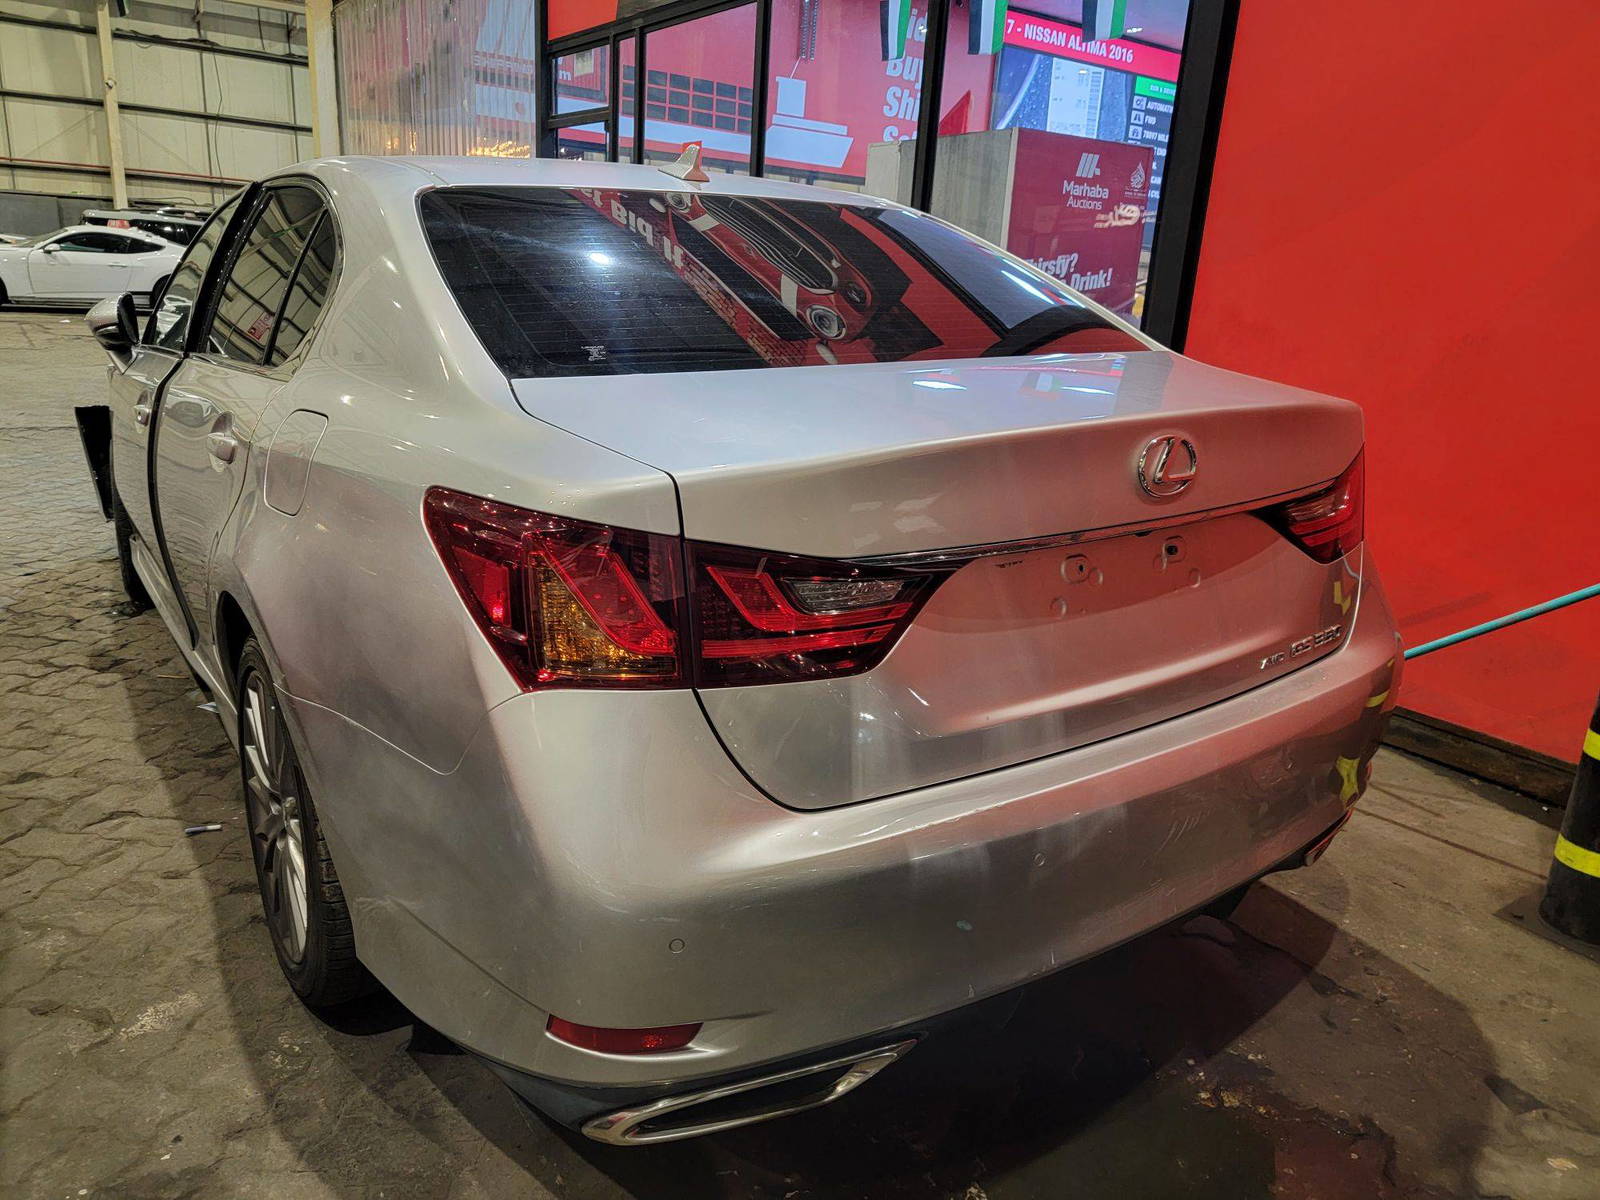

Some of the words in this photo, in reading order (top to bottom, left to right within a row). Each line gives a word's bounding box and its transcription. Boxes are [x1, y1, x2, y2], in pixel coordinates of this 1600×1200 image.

[1023, 23, 1067, 48] NISSAN
[1108, 43, 1134, 64] 2016
[883, 86, 920, 122] Shi
[1146, 100, 1174, 114] AUTOMATI
[1062, 180, 1109, 199] Marhaba
[1066, 196, 1103, 210] Auctions
[1070, 267, 1113, 292] Drink!
